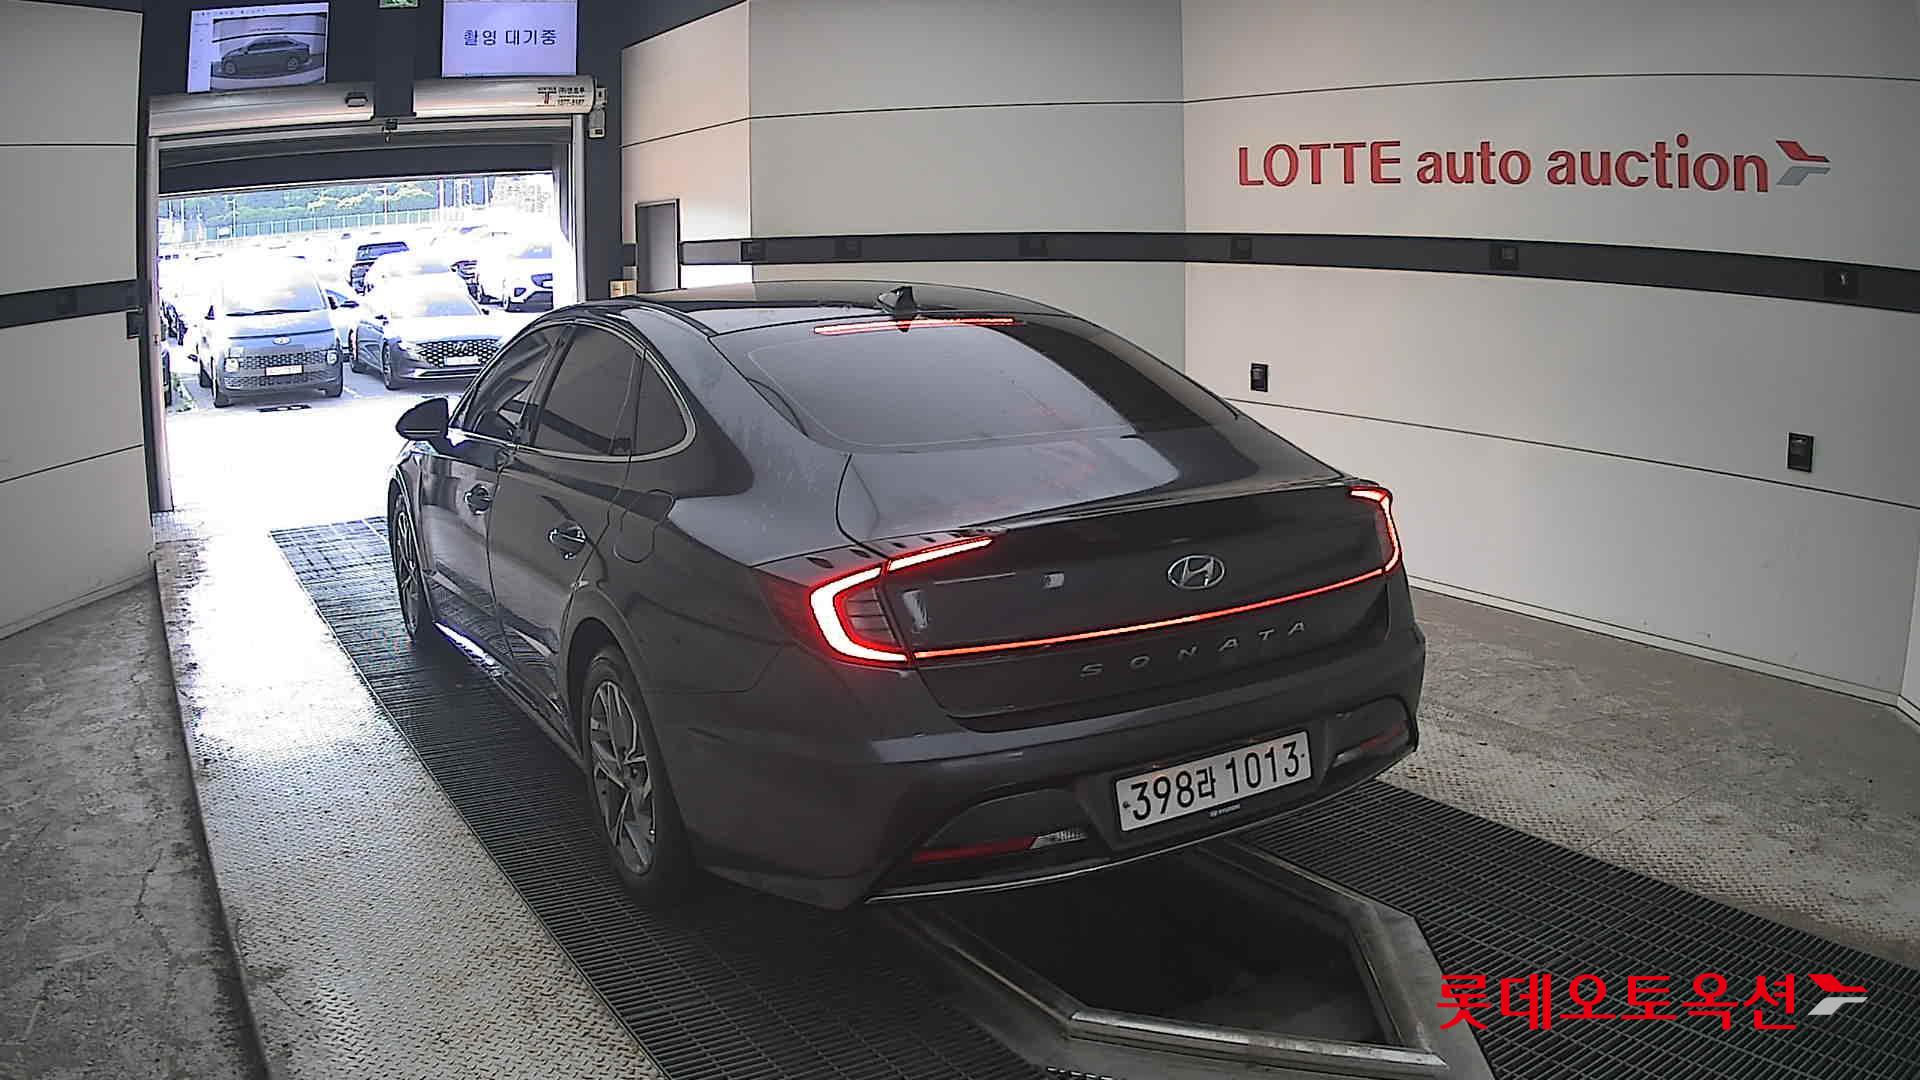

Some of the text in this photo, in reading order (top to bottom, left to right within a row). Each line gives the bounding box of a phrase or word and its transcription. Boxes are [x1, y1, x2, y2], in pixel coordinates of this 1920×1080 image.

[505, 29, 558, 46] 대기중
[1238, 133, 1769, 193] LOTTE auto auction
[1080, 621, 1306, 678] SONATA
[1129, 740, 1300, 821] 398라 1013
